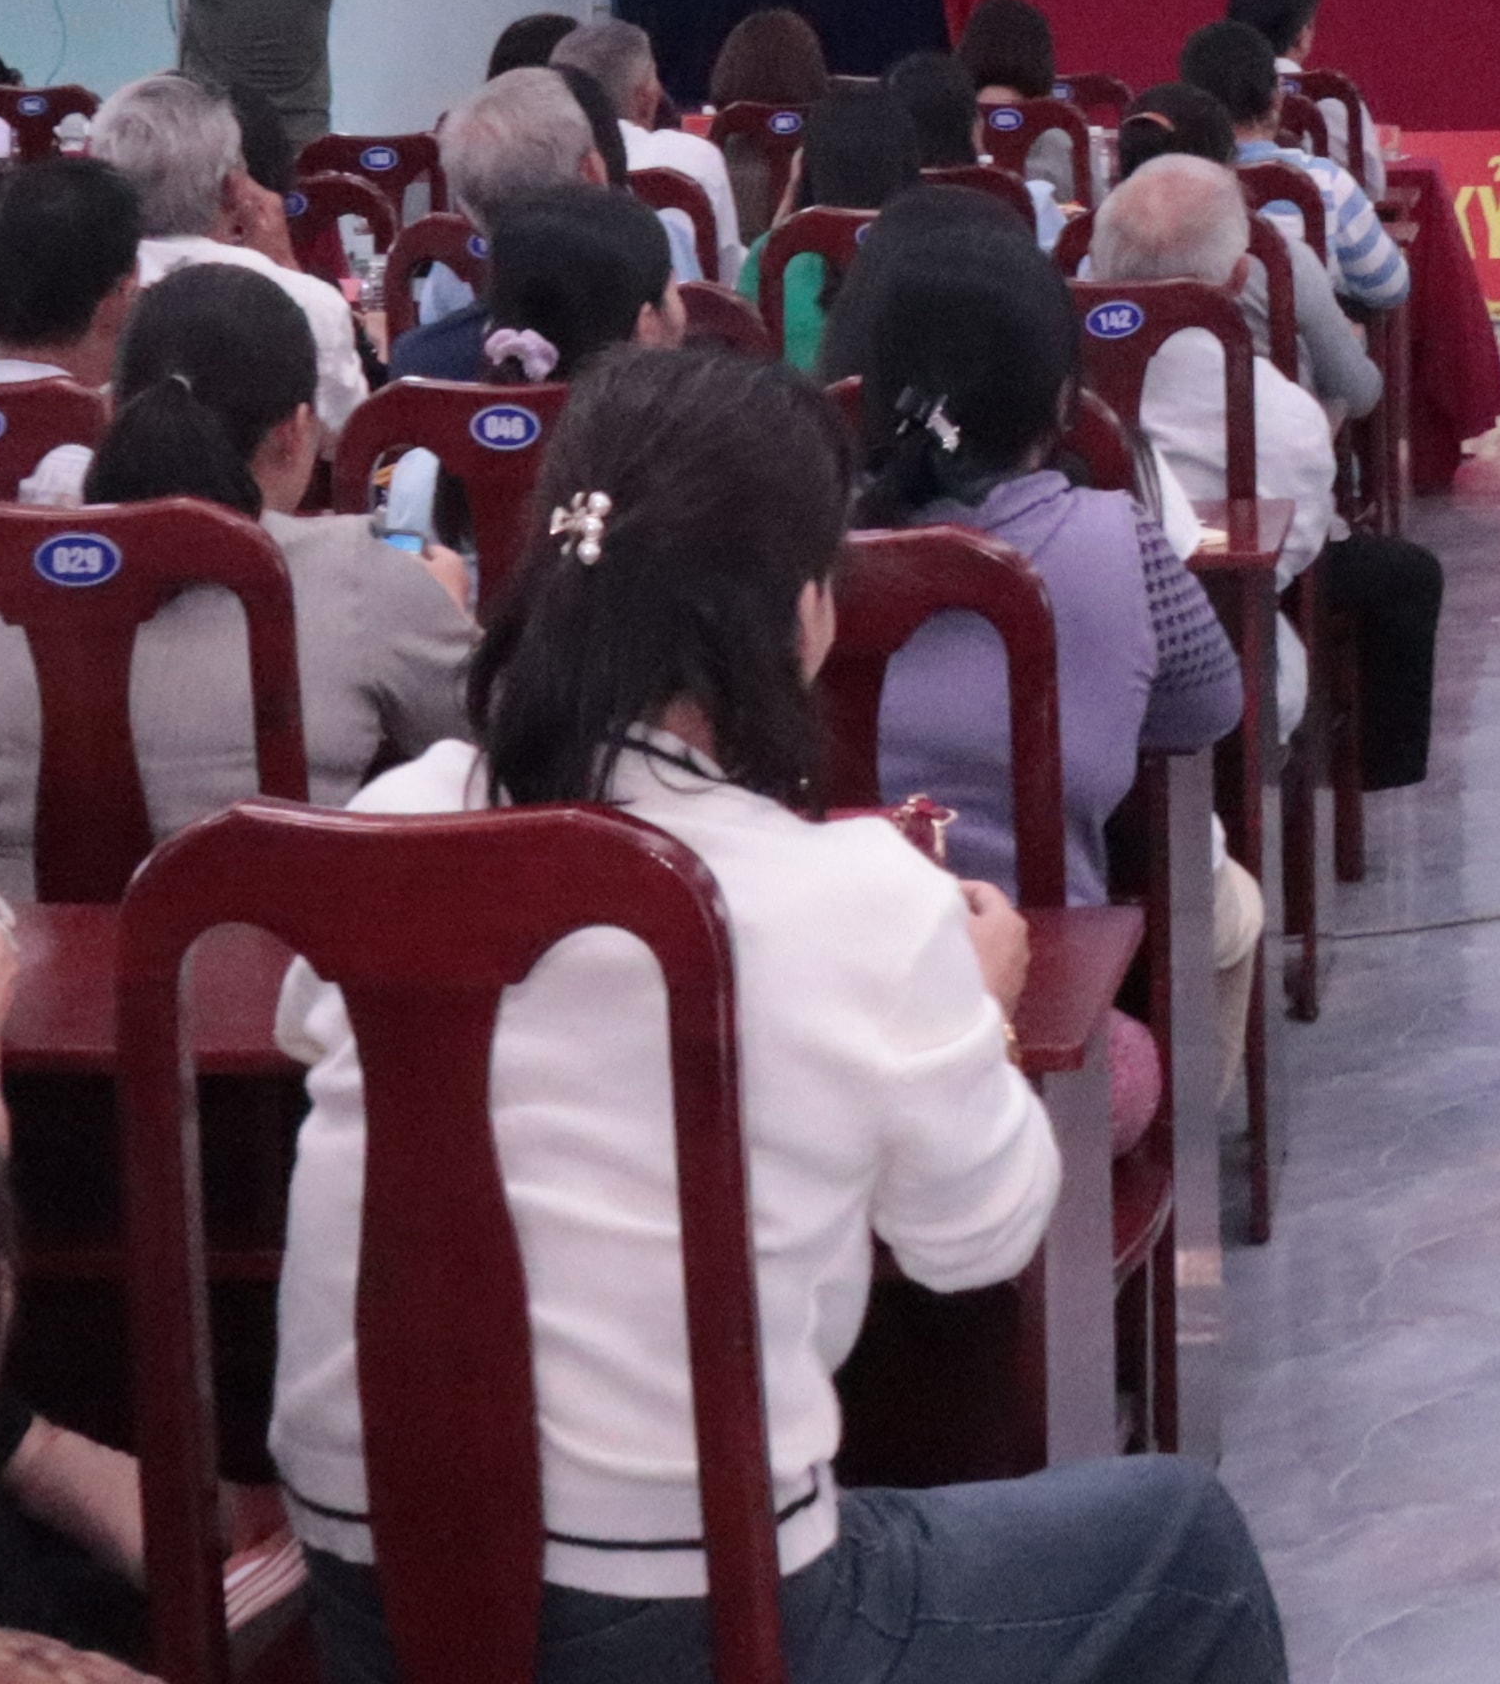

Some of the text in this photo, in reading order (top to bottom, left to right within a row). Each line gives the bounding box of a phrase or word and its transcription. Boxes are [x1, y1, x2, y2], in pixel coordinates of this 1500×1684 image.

[1098, 310, 1132, 332] 142
[483, 416, 526, 440] 046
[52, 547, 102, 575] 029
